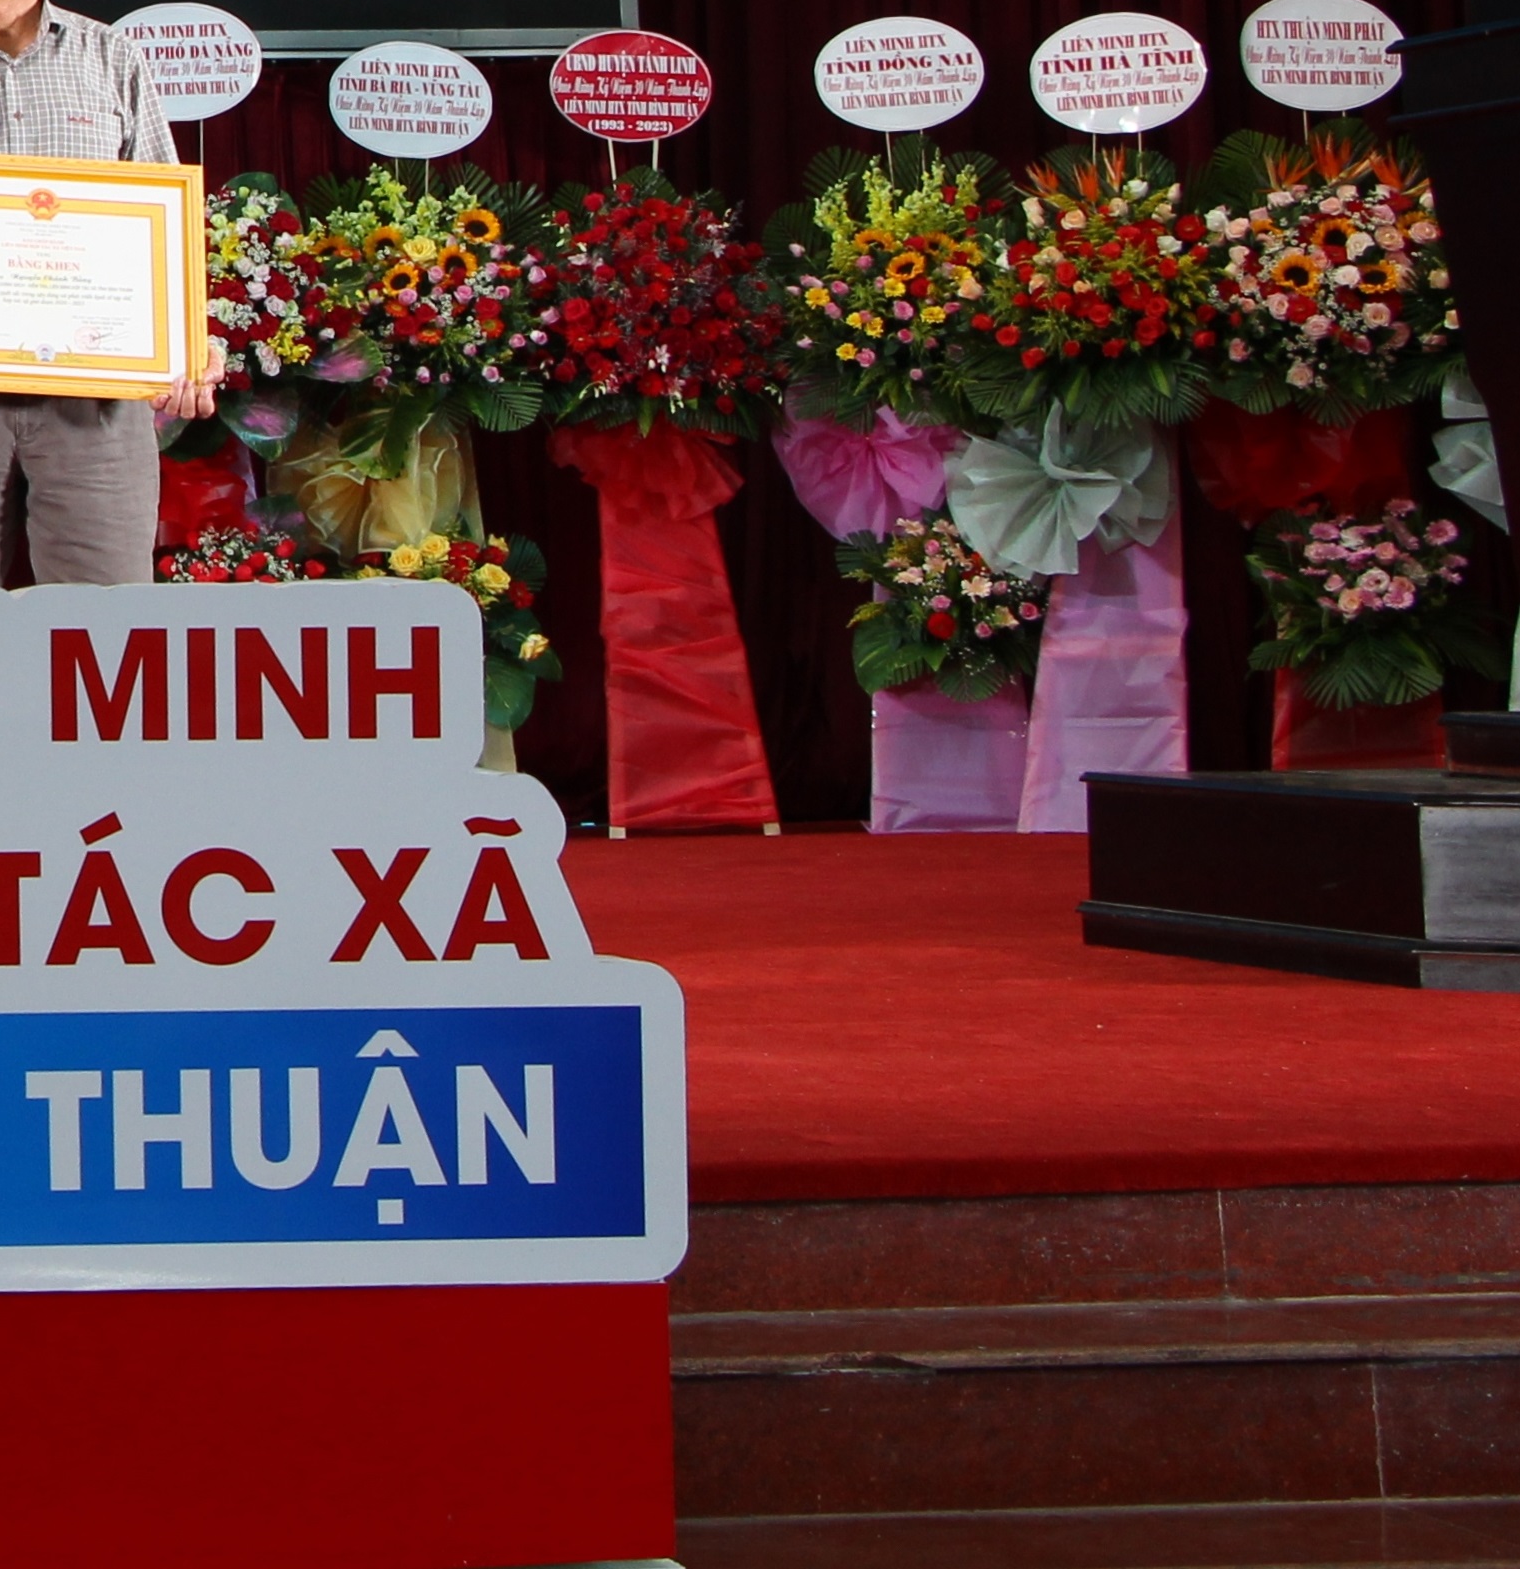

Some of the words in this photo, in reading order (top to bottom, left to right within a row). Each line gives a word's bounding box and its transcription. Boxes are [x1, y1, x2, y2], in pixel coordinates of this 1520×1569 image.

[160, 24, 194, 39] MINH
[199, 23, 227, 38] HTX
[1257, 20, 1279, 38] HTX
[1283, 16, 1320, 45] THUẬN
[1323, 21, 1351, 40] MINH
[156, 39, 185, 60] PHỐ
[846, 37, 876, 53] LIÊN
[880, 37, 914, 51] MINH
[918, 34, 946, 47] HTX
[1062, 35, 1093, 53] LIÊN
[1098, 35, 1134, 49] MINH
[1139, 32, 1168, 46] HTX
[361, 58, 391, 74] LIÊN
[395, 63, 428, 77] MINH
[433, 65, 460, 79] HTX
[566, 54, 596, 71] UBND
[598, 50, 635, 77] HUYỆN
[638, 51, 667, 73] TÁNH
[671, 56, 696, 74] LINH
[823, 57, 871, 75] TỈNH
[939, 53, 974, 66] NAI
[1101, 51, 1131, 70] HÀ
[165, 82, 182, 96] HTX
[185, 79, 207, 95] BÌNH
[211, 77, 240, 97] THUẬN
[338, 73, 366, 91] TỈNH
[370, 77, 386, 92] BÀ
[391, 80, 412, 98] RỊA
[423, 80, 454, 96] VŨNG
[459, 82, 482, 98] TÀU
[349, 114, 369, 130] LIÊN
[372, 118, 393, 131] MINH
[396, 119, 413, 133] HTX
[417, 117, 437, 134] BÌNH
[440, 119, 469, 138] THUẬN
[588, 119, 625, 133] (1993
[636, 120, 673, 134] 2023)
[8, 255, 42, 269] BẰNG
[46, 261, 80, 271] KHEN
[50, 626, 442, 742] MINH
[329, 815, 550, 962] XÃ
[25, 1029, 556, 1225] THUẬN
